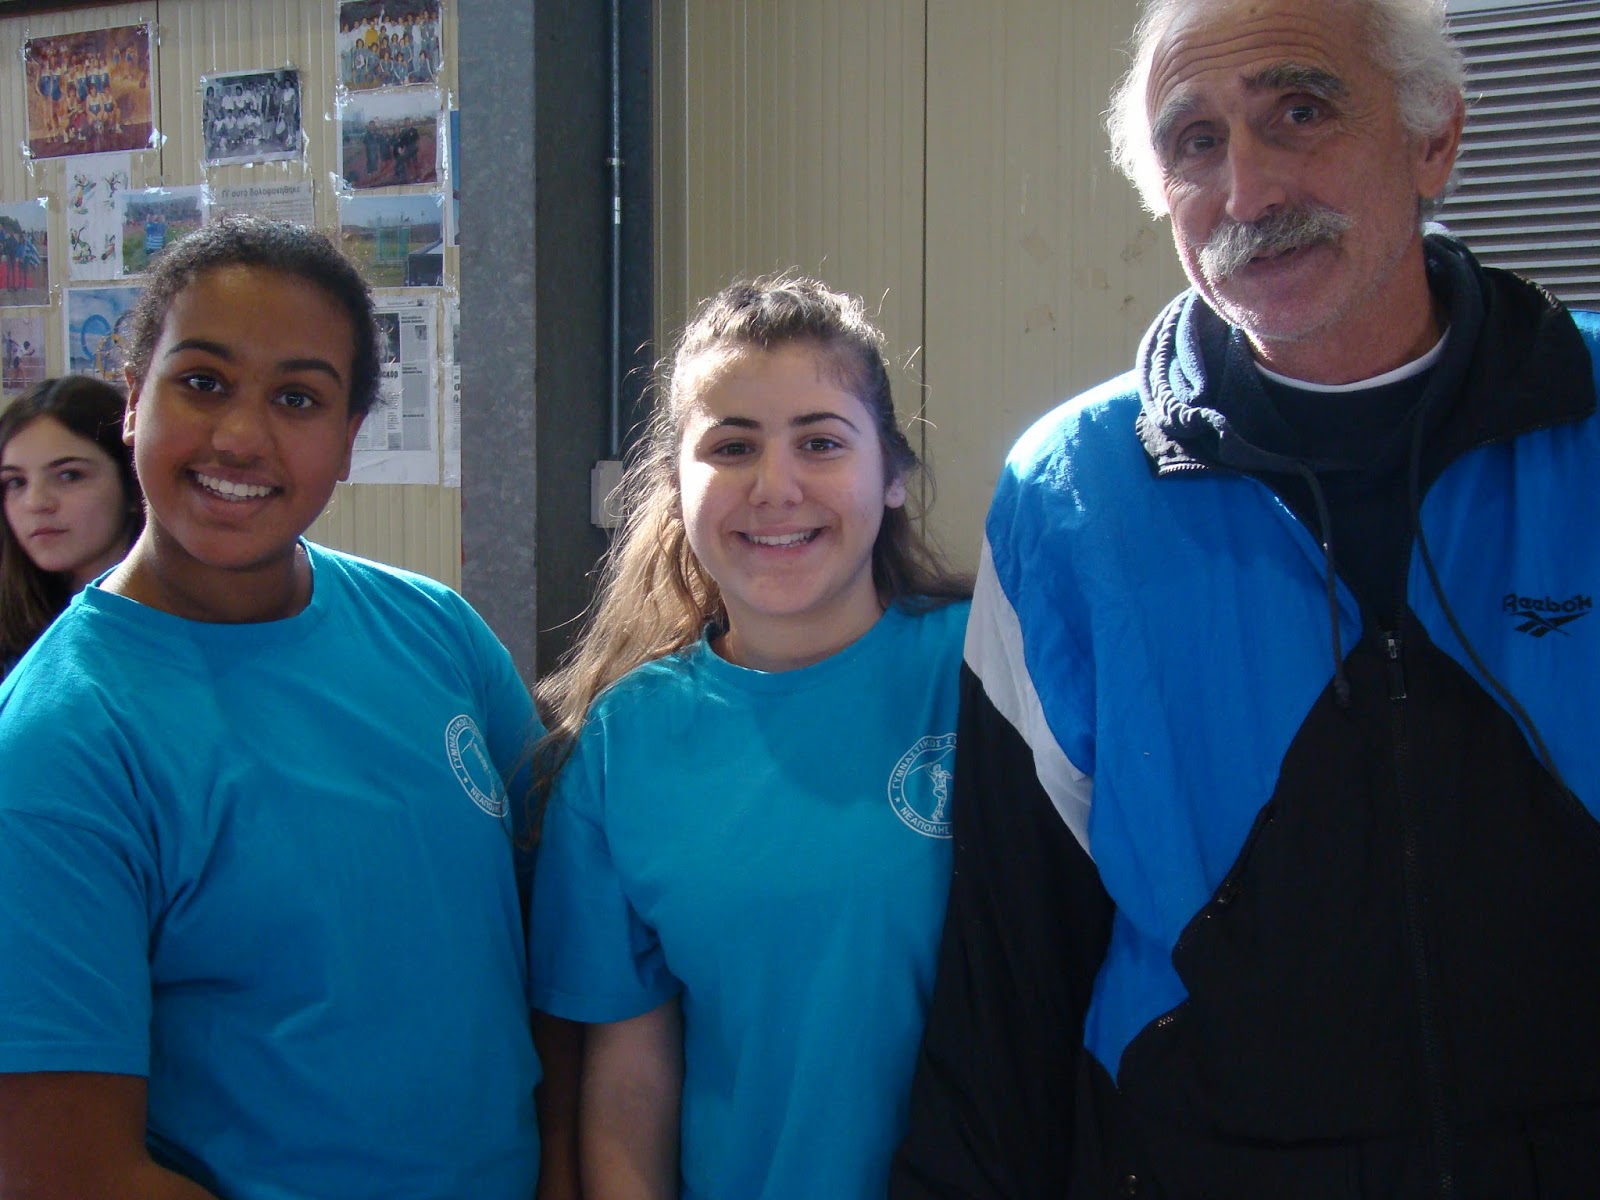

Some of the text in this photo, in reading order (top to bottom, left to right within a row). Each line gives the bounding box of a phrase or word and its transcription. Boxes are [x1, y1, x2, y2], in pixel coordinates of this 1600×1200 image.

[1503, 592, 1593, 612] Reebok
[891, 739, 942, 789] ΓΥΜΝΑΣΤΙΚΟΣ
[900, 806, 950, 834] ΝΕΑΠΟΛΗΣ
